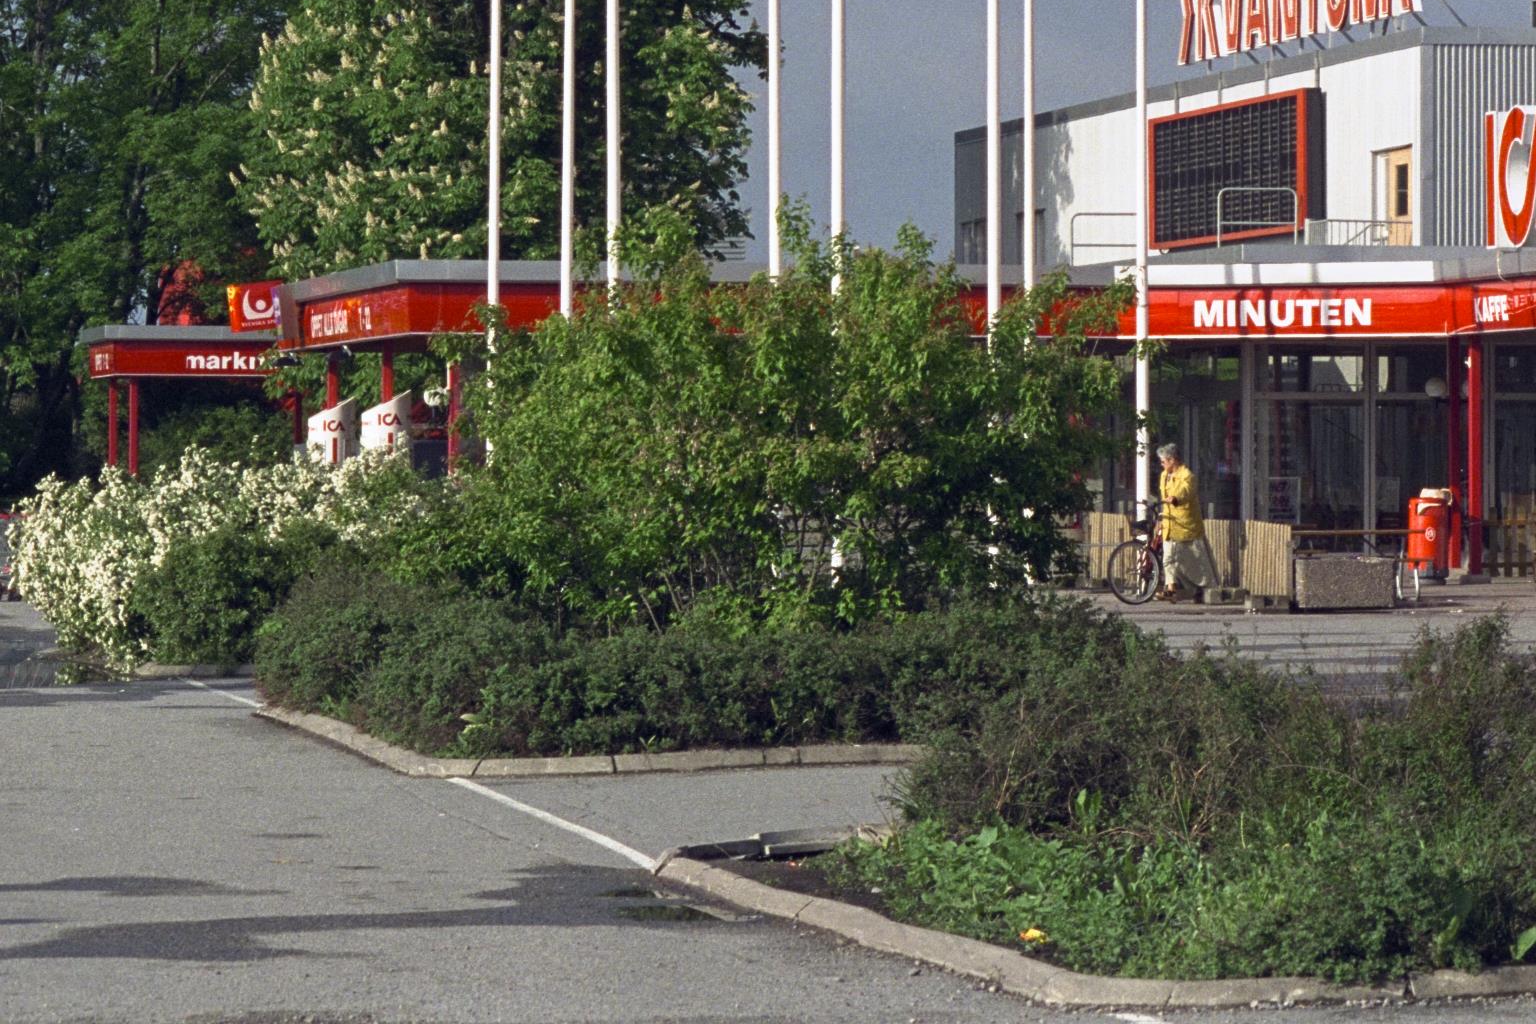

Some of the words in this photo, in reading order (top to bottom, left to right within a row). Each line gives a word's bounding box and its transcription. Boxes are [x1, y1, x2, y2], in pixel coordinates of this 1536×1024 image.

[1193, 298, 1372, 328] MINUTEN
[1474, 295, 1510, 323] KAFFE
[323, 419, 345, 432] ICA
[377, 413, 402, 426] ICA
